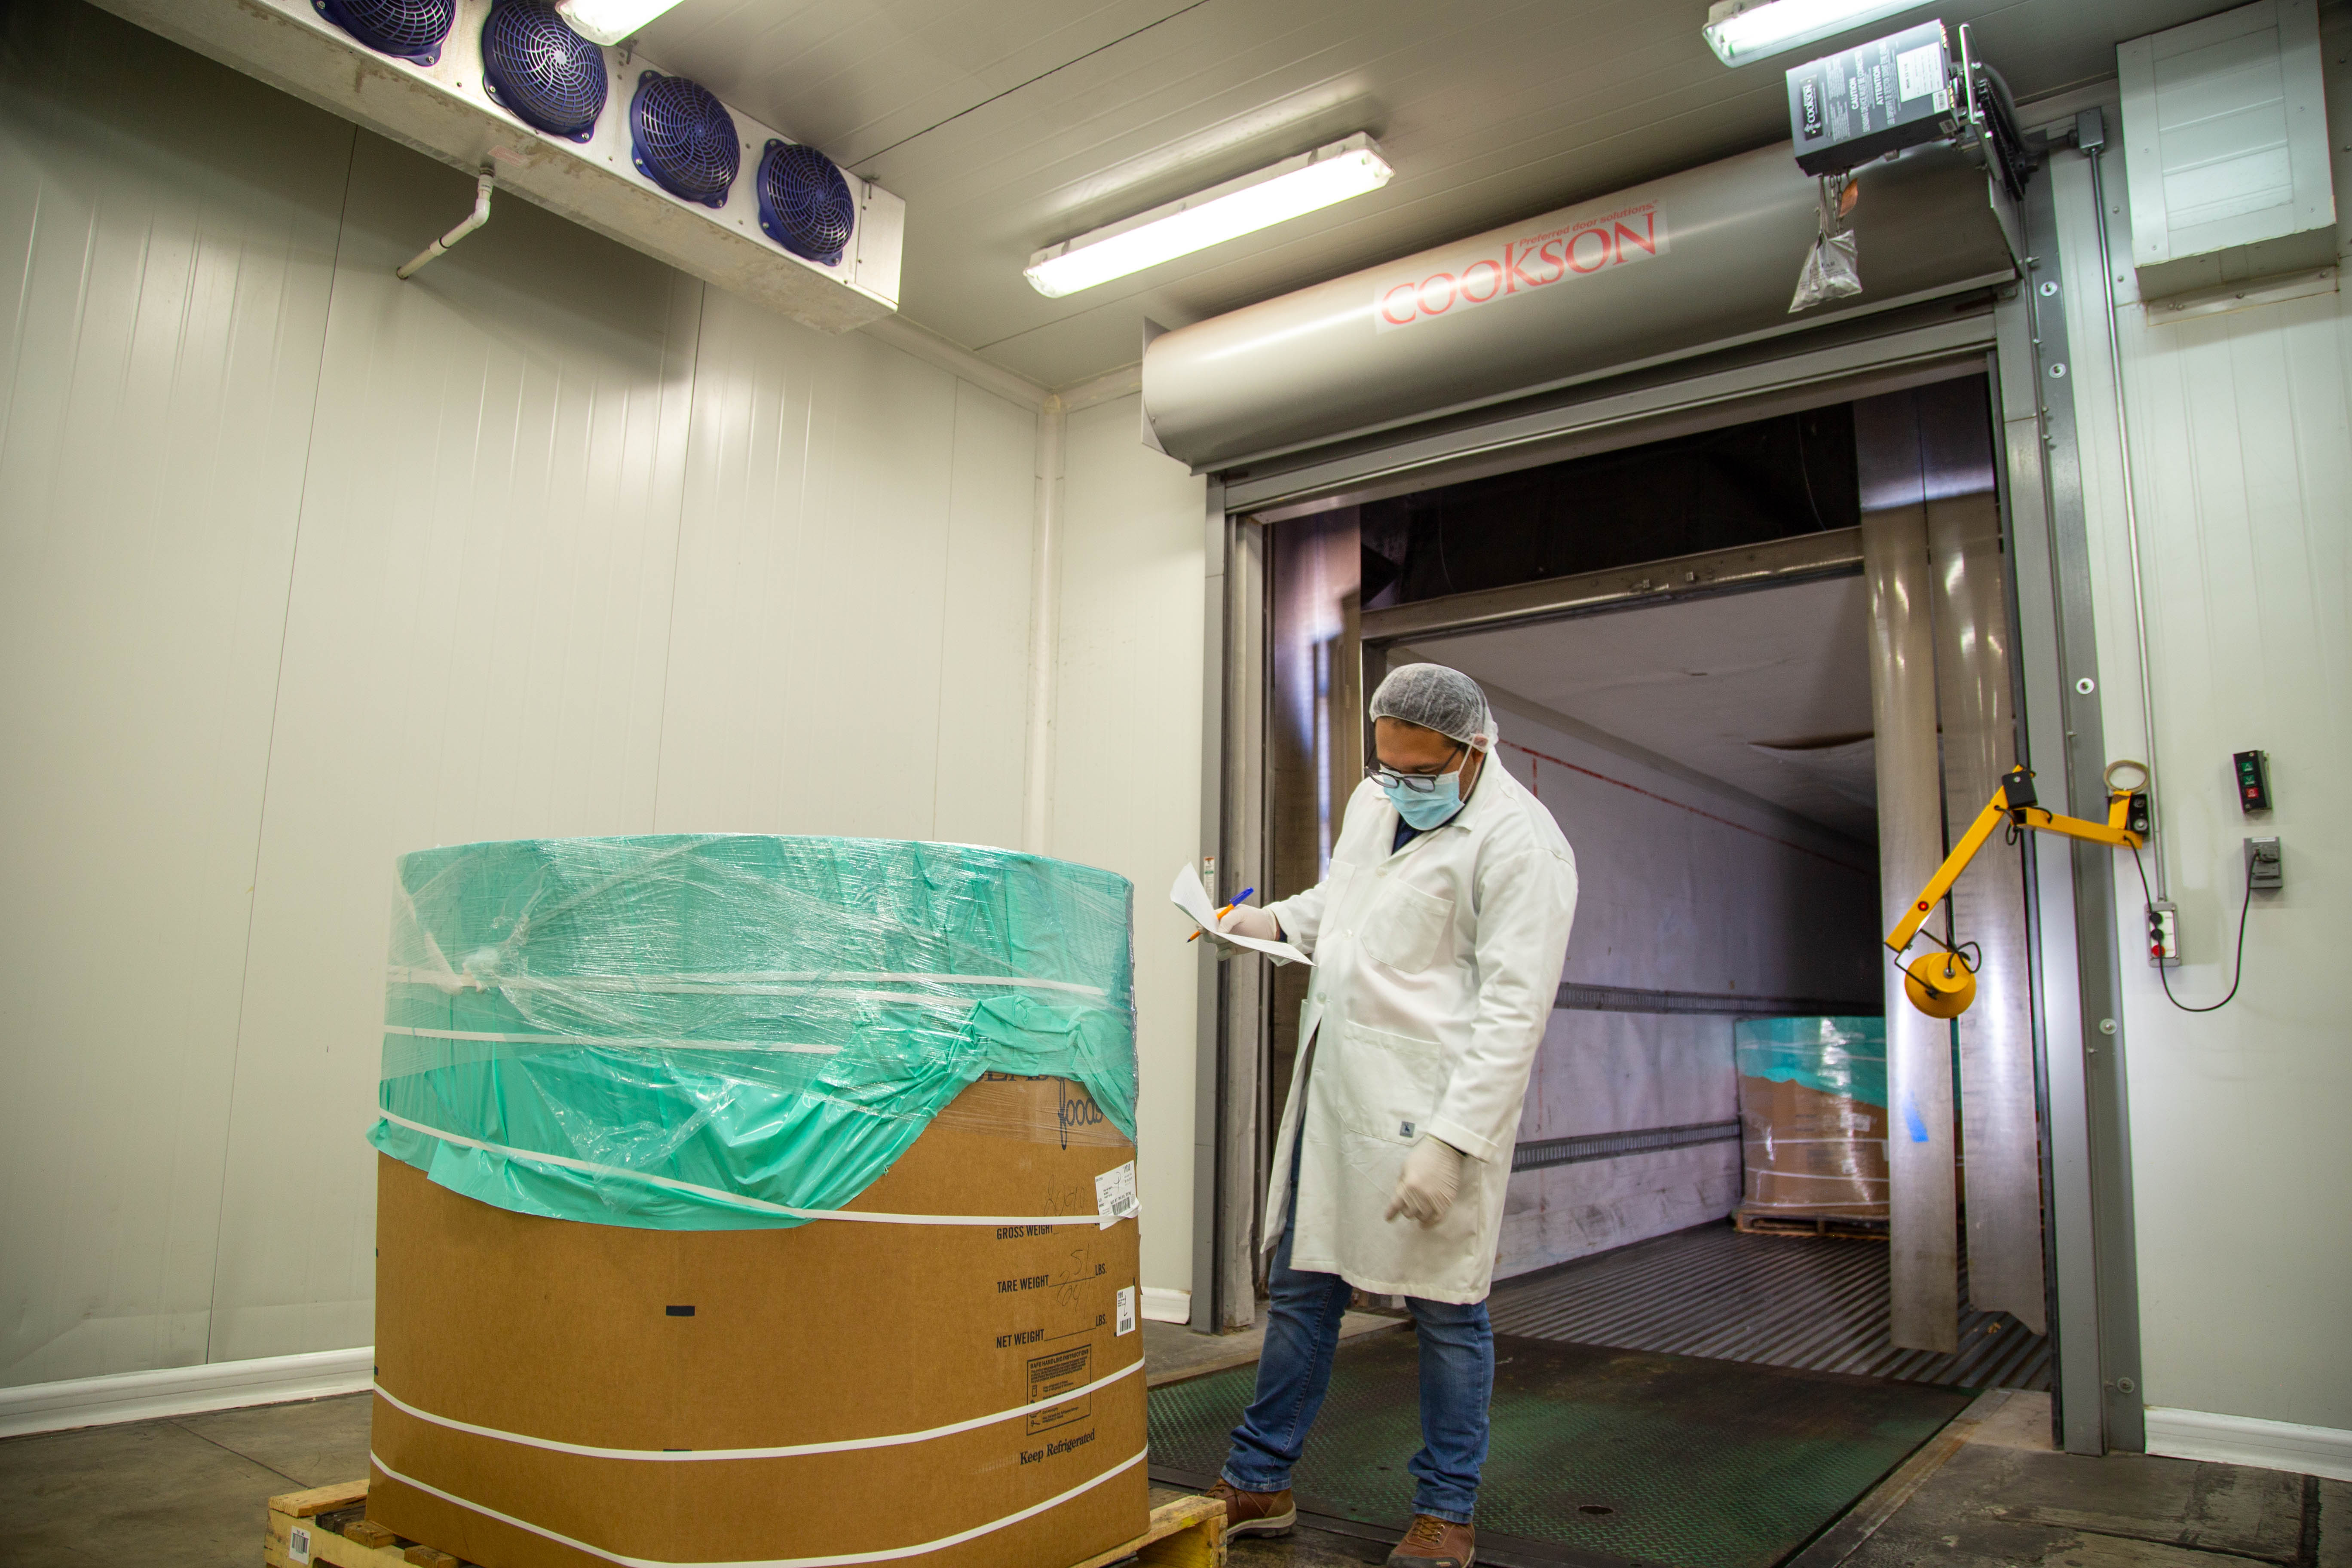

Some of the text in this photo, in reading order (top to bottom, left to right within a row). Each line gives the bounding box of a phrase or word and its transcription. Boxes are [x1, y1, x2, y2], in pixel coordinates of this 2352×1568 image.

[1849, 77, 1858, 110] CAUTION
[1872, 64, 1883, 106] ATTENTION
[1802, 83, 1816, 124] COOKSON
[1519, 226, 1570, 247] Preferred
[1572, 218, 1598, 232] door
[1381, 210, 1657, 325] COOKSON
[997, 1225, 1053, 1240] GROSS WEIGHT
[997, 1263, 1107, 1293] TARE WEIGHT LBS.
[996, 1314, 1107, 1349] NET WEIGHT LBS.
[1042, 1356, 1063, 1366] HANDLING
[1063, 1348, 1089, 1361] INSTRUCTIONS
[1020, 1427, 1095, 1465] Keep Refrigerated
